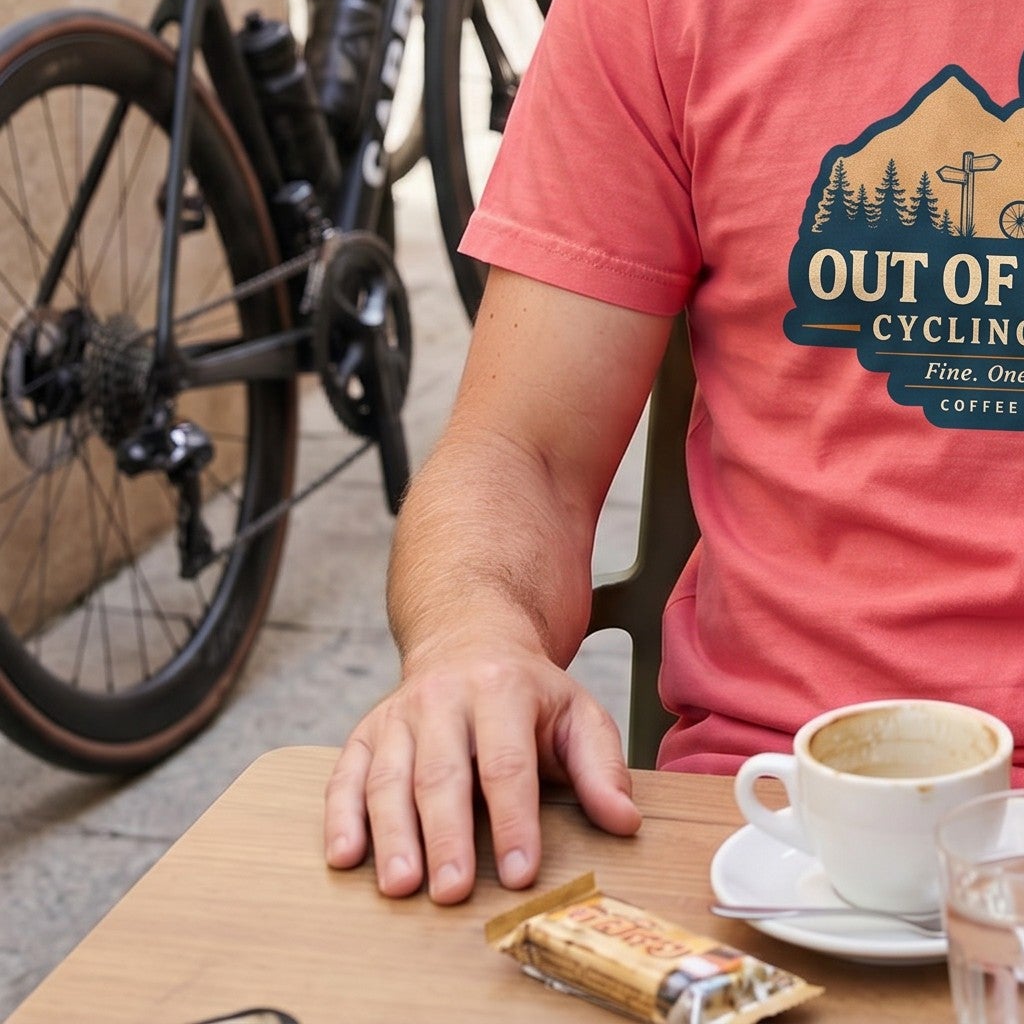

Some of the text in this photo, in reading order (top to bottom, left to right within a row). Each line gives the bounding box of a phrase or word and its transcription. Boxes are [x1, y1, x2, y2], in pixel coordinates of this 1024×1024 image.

[808, 248, 929, 303] OUT
[942, 253, 1019, 307] OF
[925, 362, 978, 383] Fine.
[940, 399, 1018, 414] COFFEE
